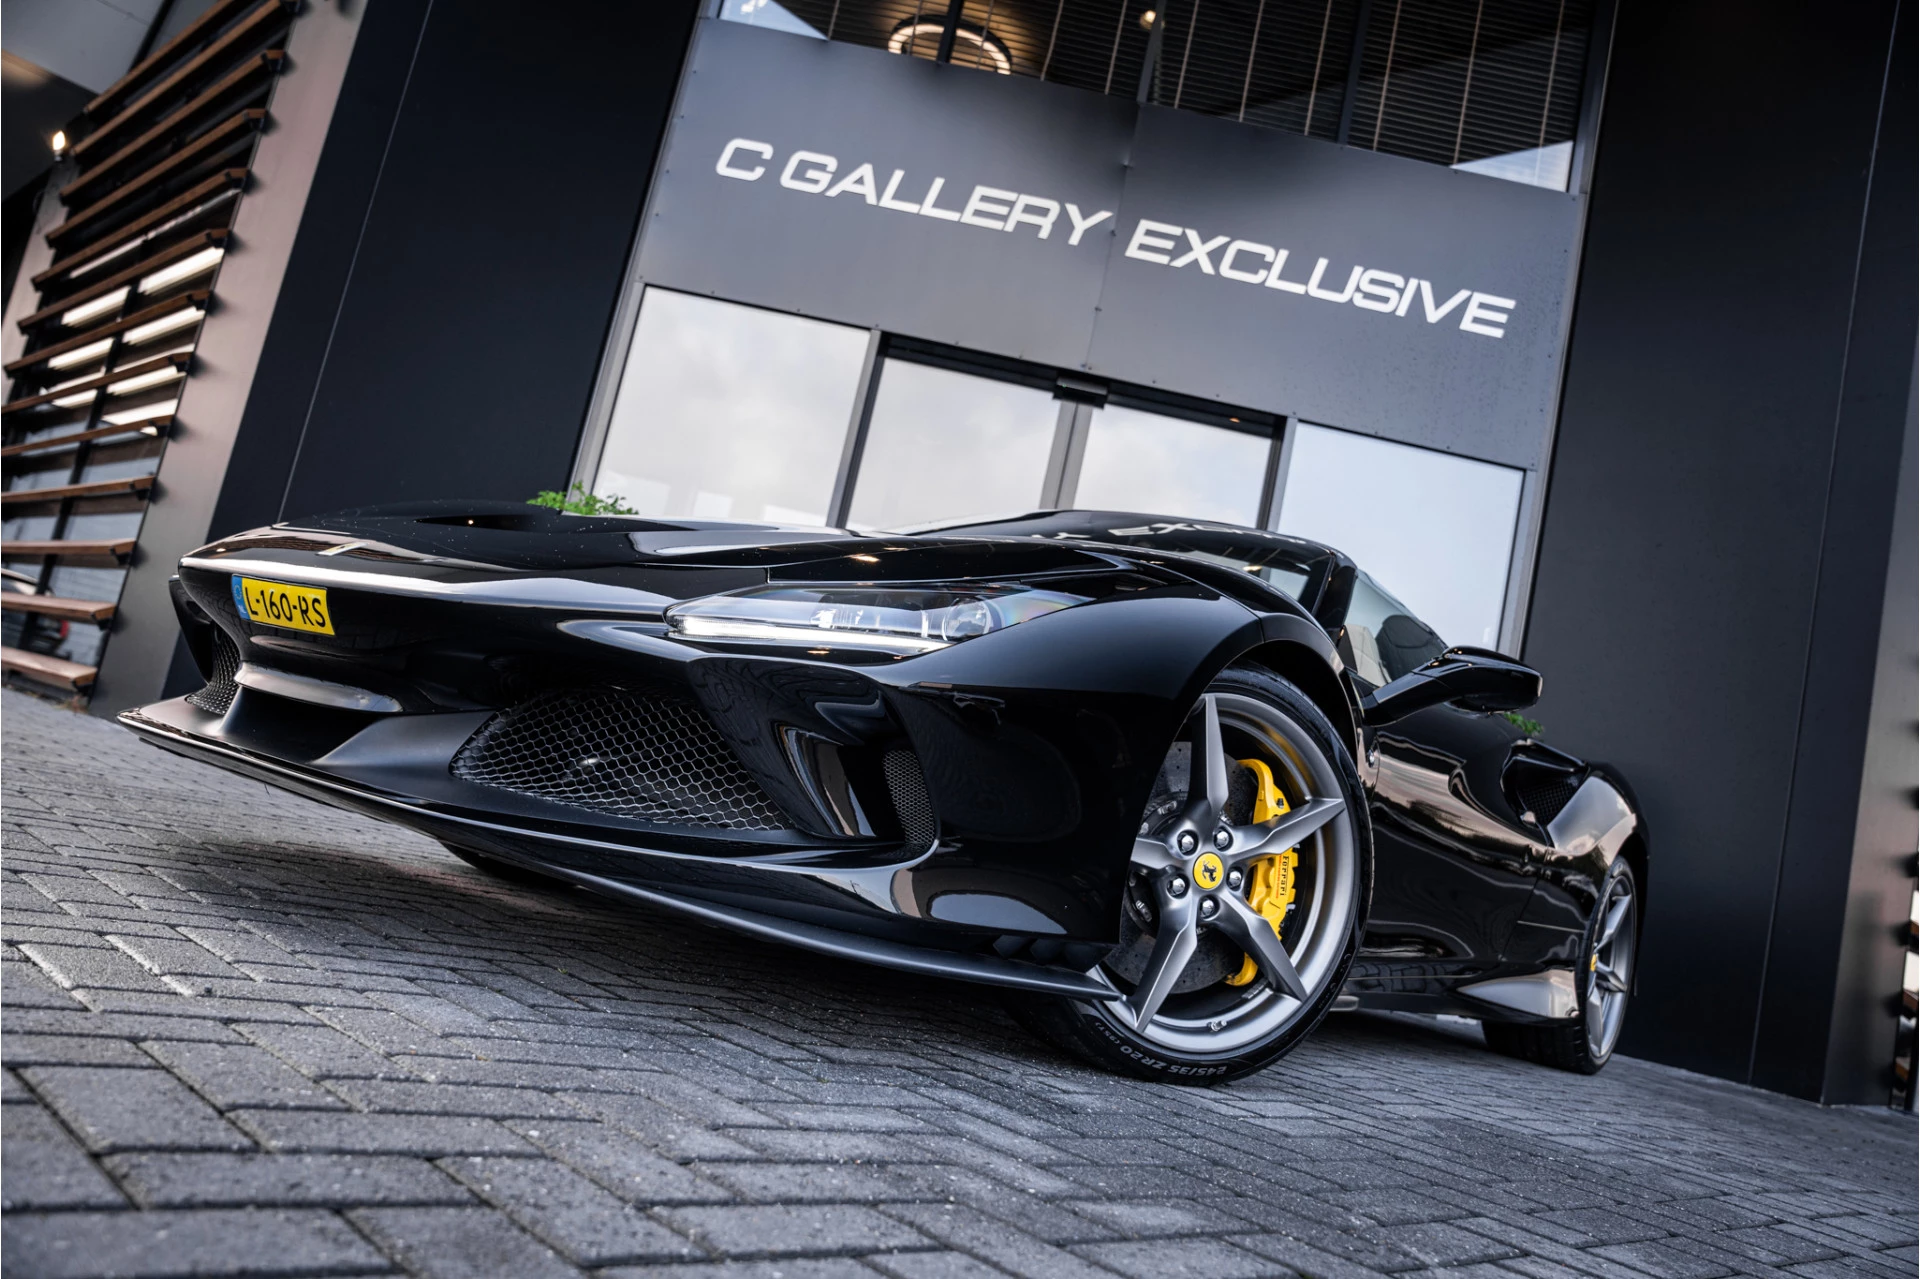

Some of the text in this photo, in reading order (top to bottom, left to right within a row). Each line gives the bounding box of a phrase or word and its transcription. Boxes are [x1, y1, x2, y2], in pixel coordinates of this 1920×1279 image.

[716, 138, 1517, 339] C GALLERY EXCLUSIVE
[245, 587, 326, 628] L-160-RS
[1280, 855, 1289, 896] Ferrari
[1168, 1065, 1227, 1076] 245/35
